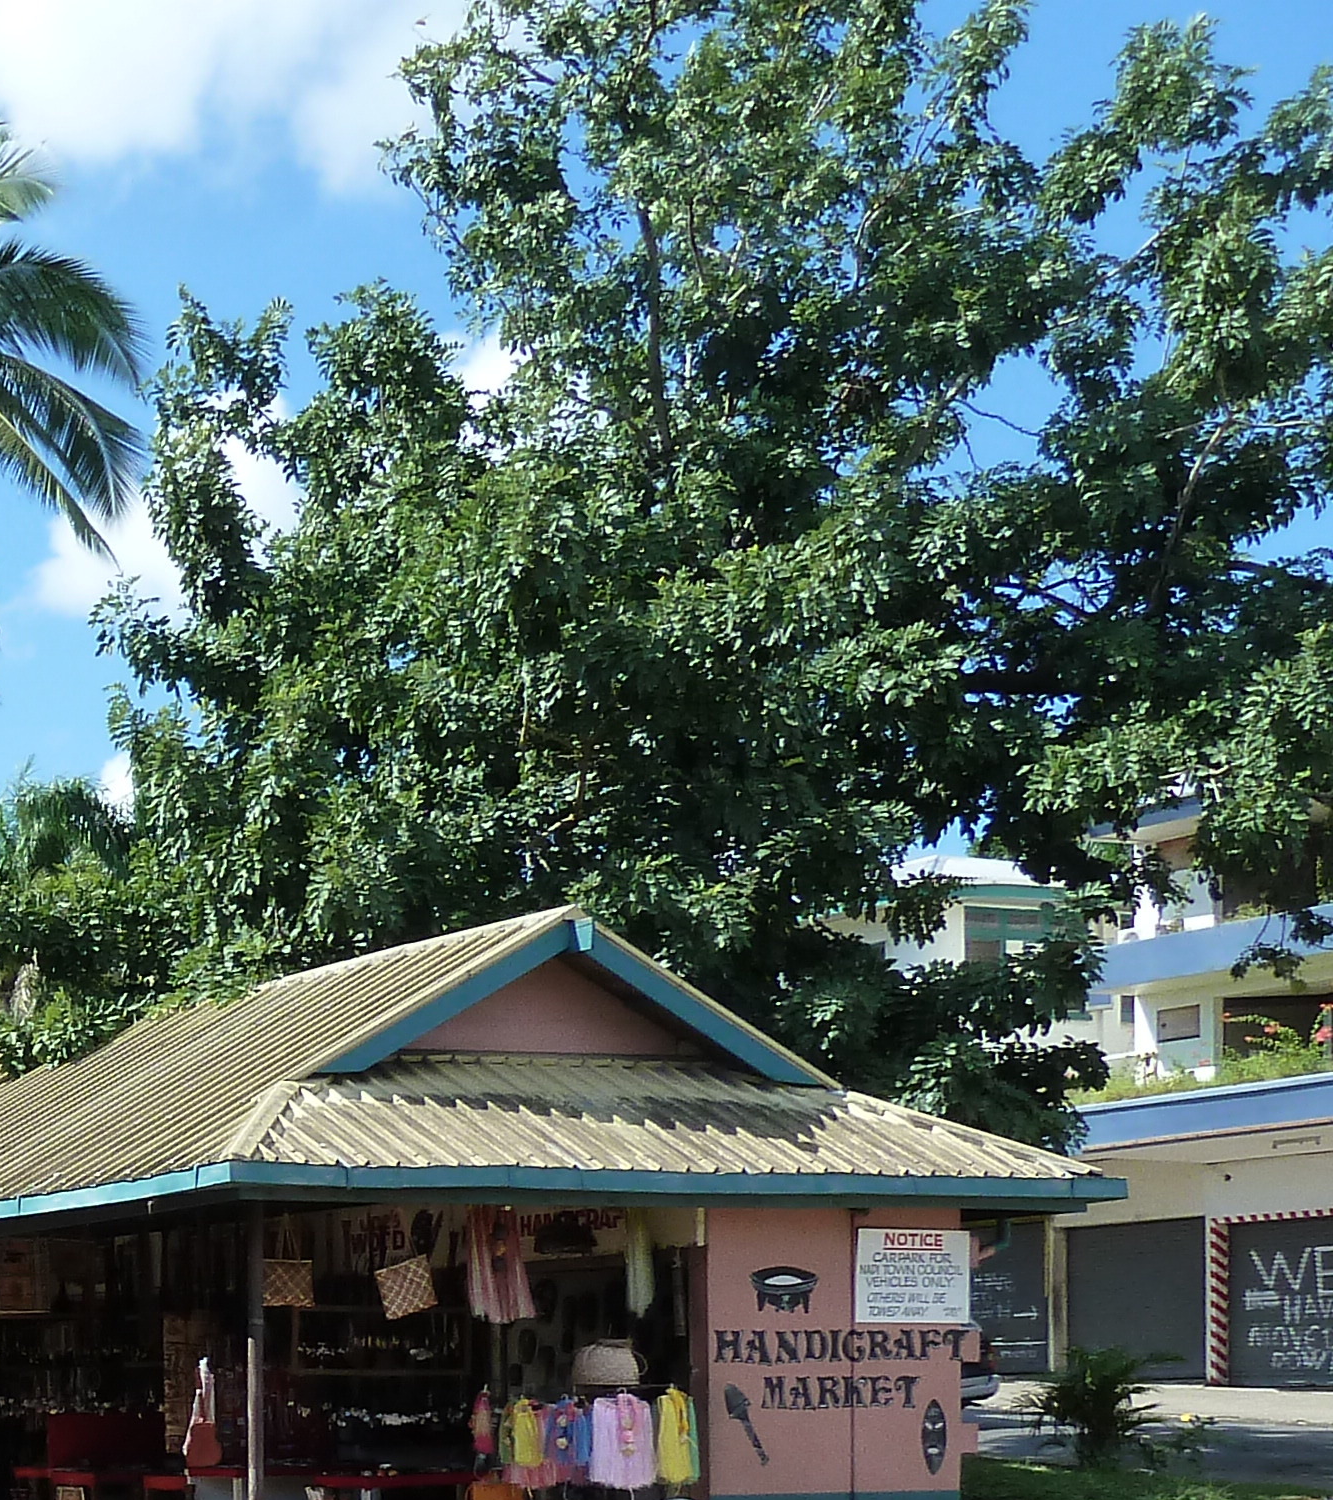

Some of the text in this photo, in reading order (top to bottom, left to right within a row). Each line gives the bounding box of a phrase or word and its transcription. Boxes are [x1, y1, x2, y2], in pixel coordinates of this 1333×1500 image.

[883, 1232, 944, 1247] NOTICE
[929, 1253, 952, 1263] FOR
[859, 1264, 964, 1276] NADI TOWN COUNCIL
[866, 1277, 918, 1288] VEHICLES
[866, 1292, 948, 1304] OTHERS WILL BE
[868, 1306, 901, 1317] TOWED
[713, 1328, 971, 1366] HANDICRAFT
[761, 1375, 921, 1411] MARKET
